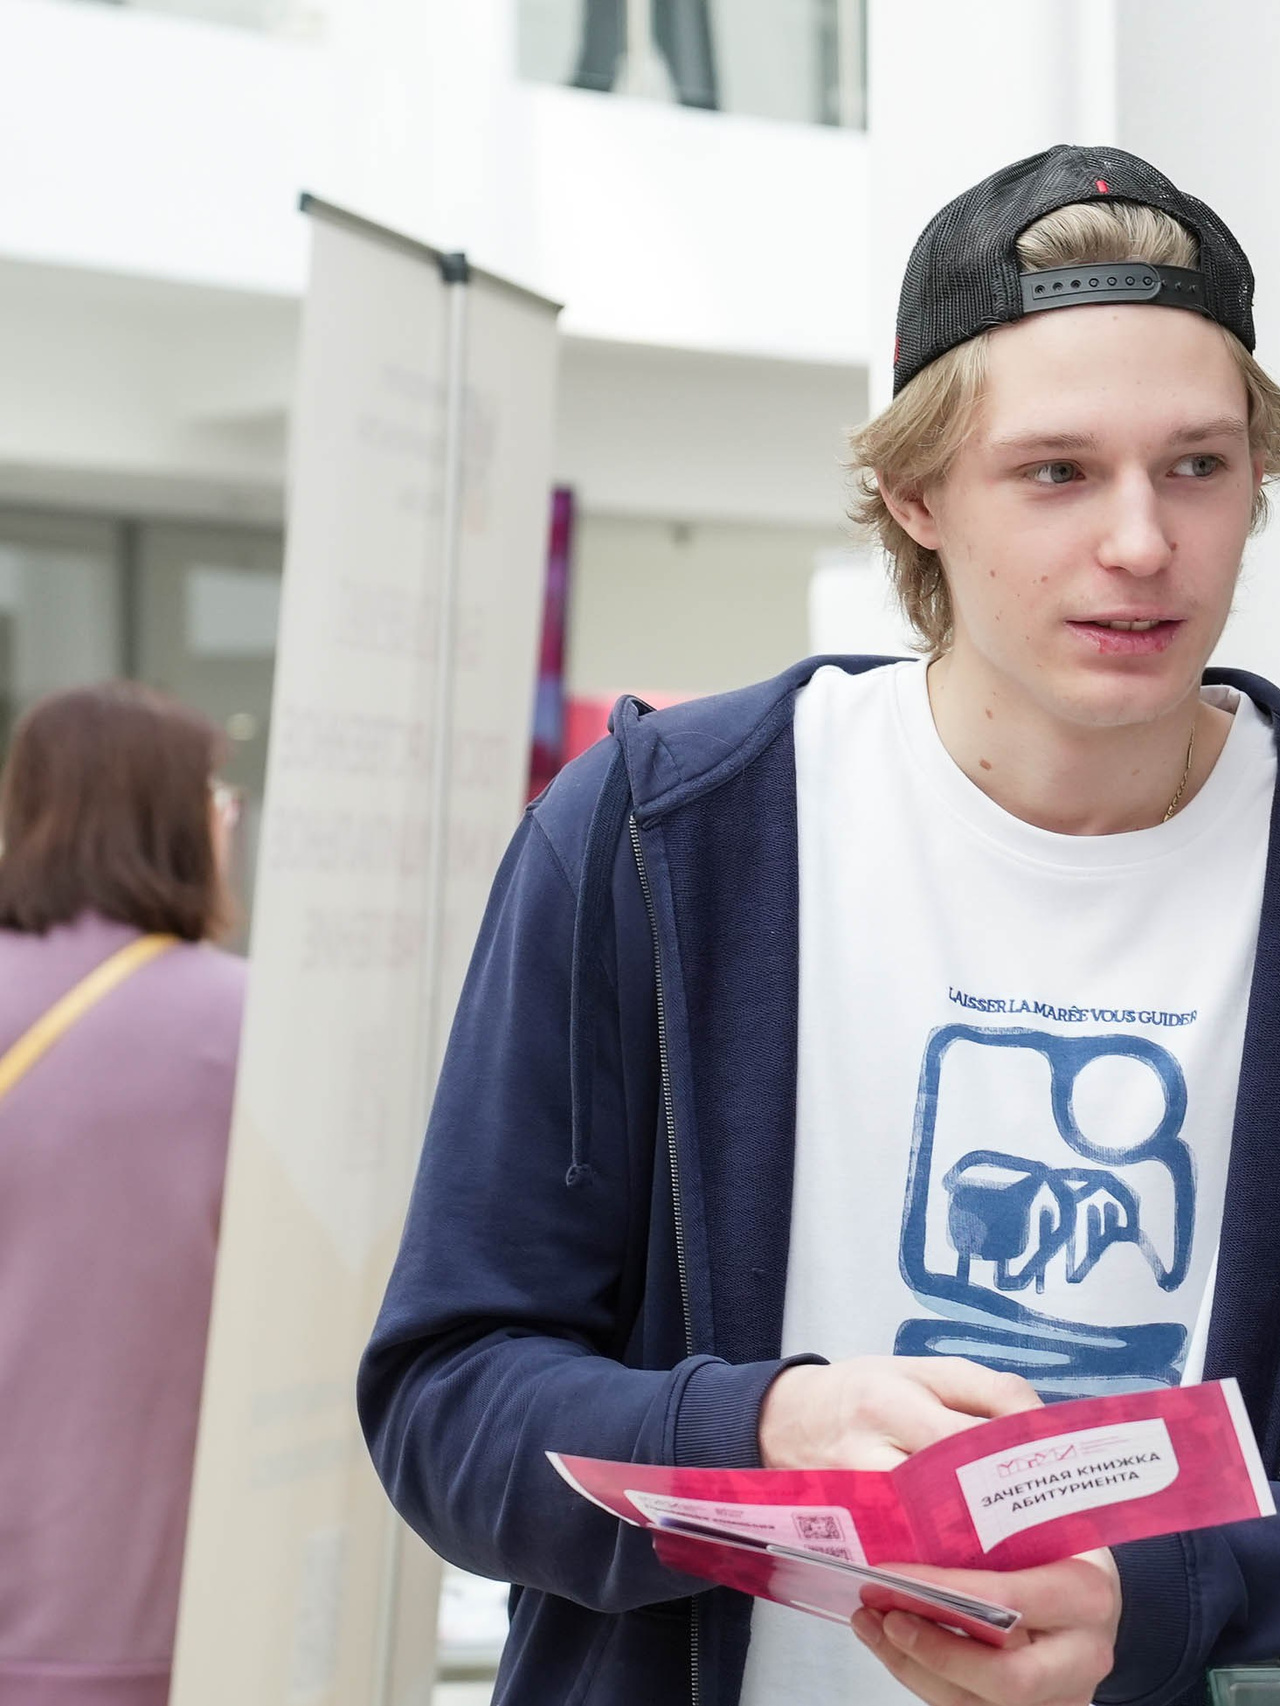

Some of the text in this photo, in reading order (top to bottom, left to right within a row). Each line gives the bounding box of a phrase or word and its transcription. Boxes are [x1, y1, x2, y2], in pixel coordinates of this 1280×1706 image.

[948, 986, 1007, 1013] LAISSER
[1009, 999, 1031, 1013] LA
[1090, 1008, 1136, 1023] VOUS
[1138, 1010, 1198, 1027] GUIDER
[981, 1469, 1072, 1507] ЗАЧЕТНАЯ
[1077, 1451, 1161, 1476] КНИЖКА
[1011, 1470, 1140, 1512] АБИТУРИЕНТА
